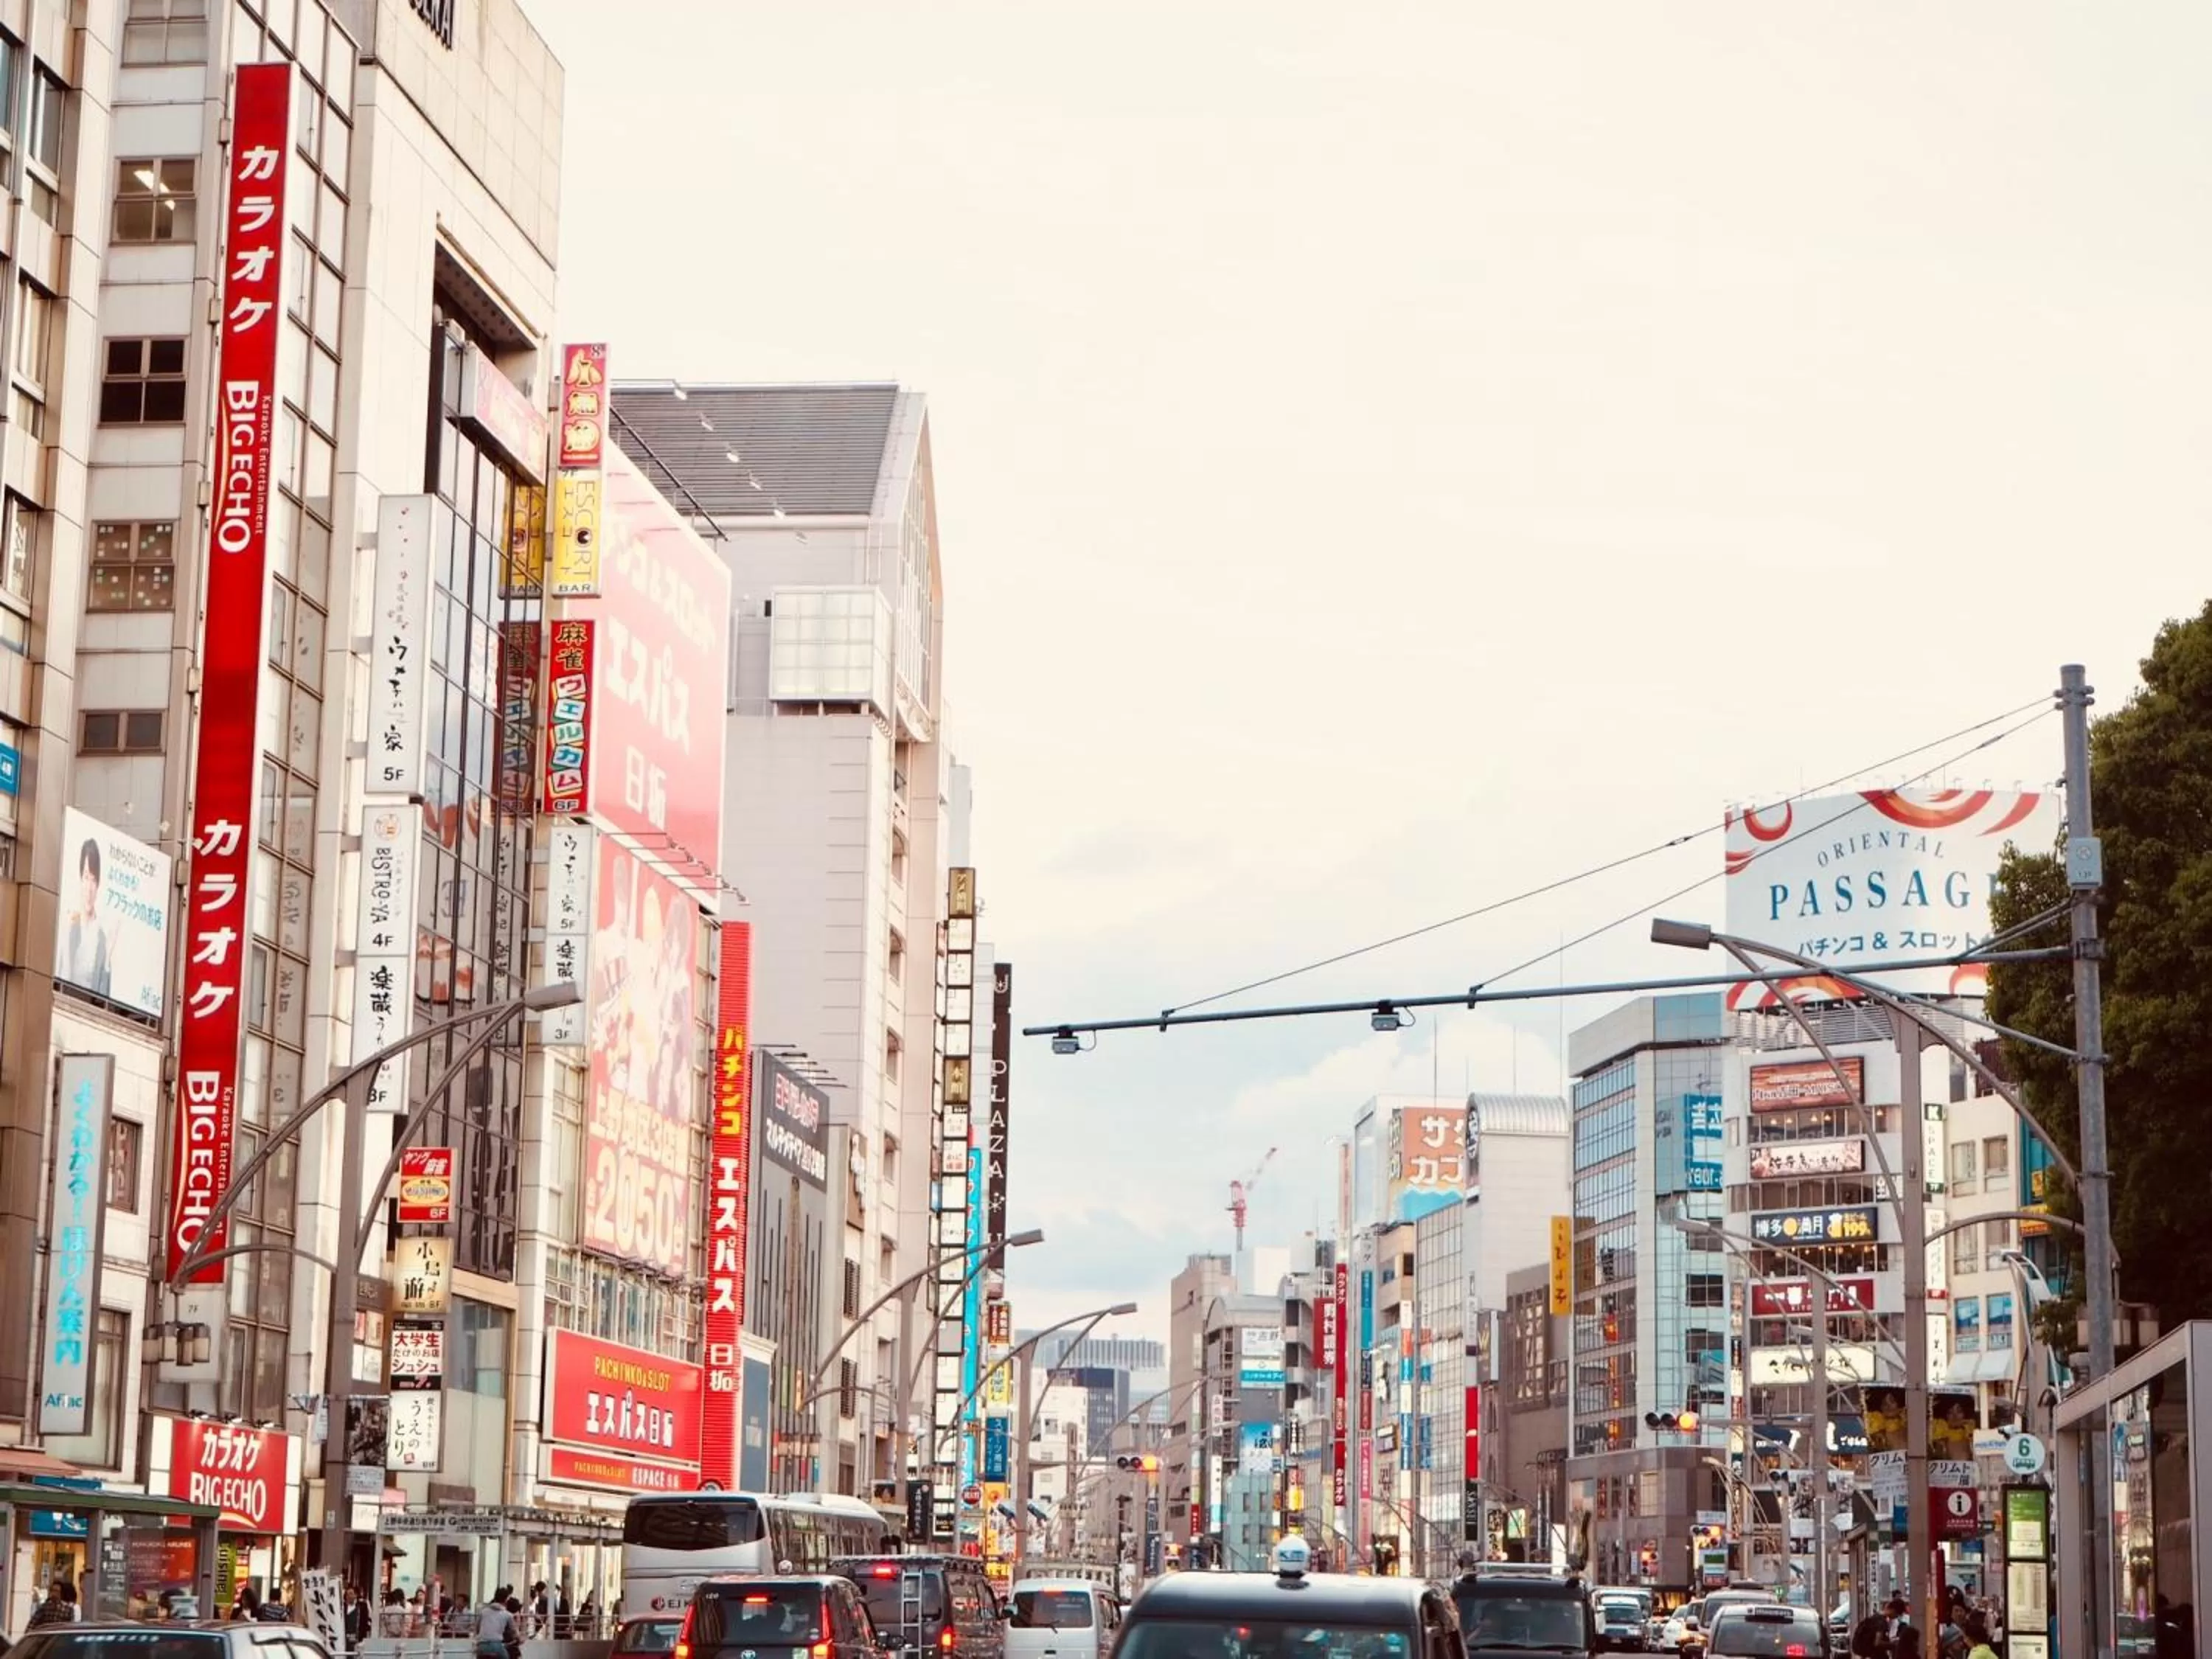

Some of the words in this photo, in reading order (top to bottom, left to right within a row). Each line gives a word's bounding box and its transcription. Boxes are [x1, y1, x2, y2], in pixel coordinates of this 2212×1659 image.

[229, 145, 279, 333] カラオケ
[226, 380, 260, 448] BIG
[260, 394, 272, 442] Karaoke
[218, 453, 253, 553] ECHO
[255, 448, 269, 535] Entertainment
[558, 584, 591, 593] BAR
[555, 623, 588, 670] 麻雀
[383, 766, 405, 782] 5F
[1818, 830, 1945, 868] ORIENTAL
[189, 819, 243, 1019] カラオケ
[1770, 870, 2000, 920] PASSAG
[372, 932, 394, 948] 4F
[1798, 933, 1864, 957] パチンコ
[1872, 932, 1888, 949] &
[1899, 931, 1980, 948] スロット
[720, 1026, 745, 1135] パチンコ
[186, 1071, 220, 1141] BIG
[220, 1085, 234, 1136] Karaoke
[989, 1060, 1008, 1178] PLAZA
[712, 1158, 740, 1313] エスパス
[394, 1332, 440, 1347] 大学生
[392, 1358, 440, 1373] シュシュ
[201, 1424, 262, 1472] カラオケ
[2017, 1438, 2031, 1456] 6
[223, 1477, 266, 1522] ECHO
[632, 1467, 665, 1487] ESPACE
